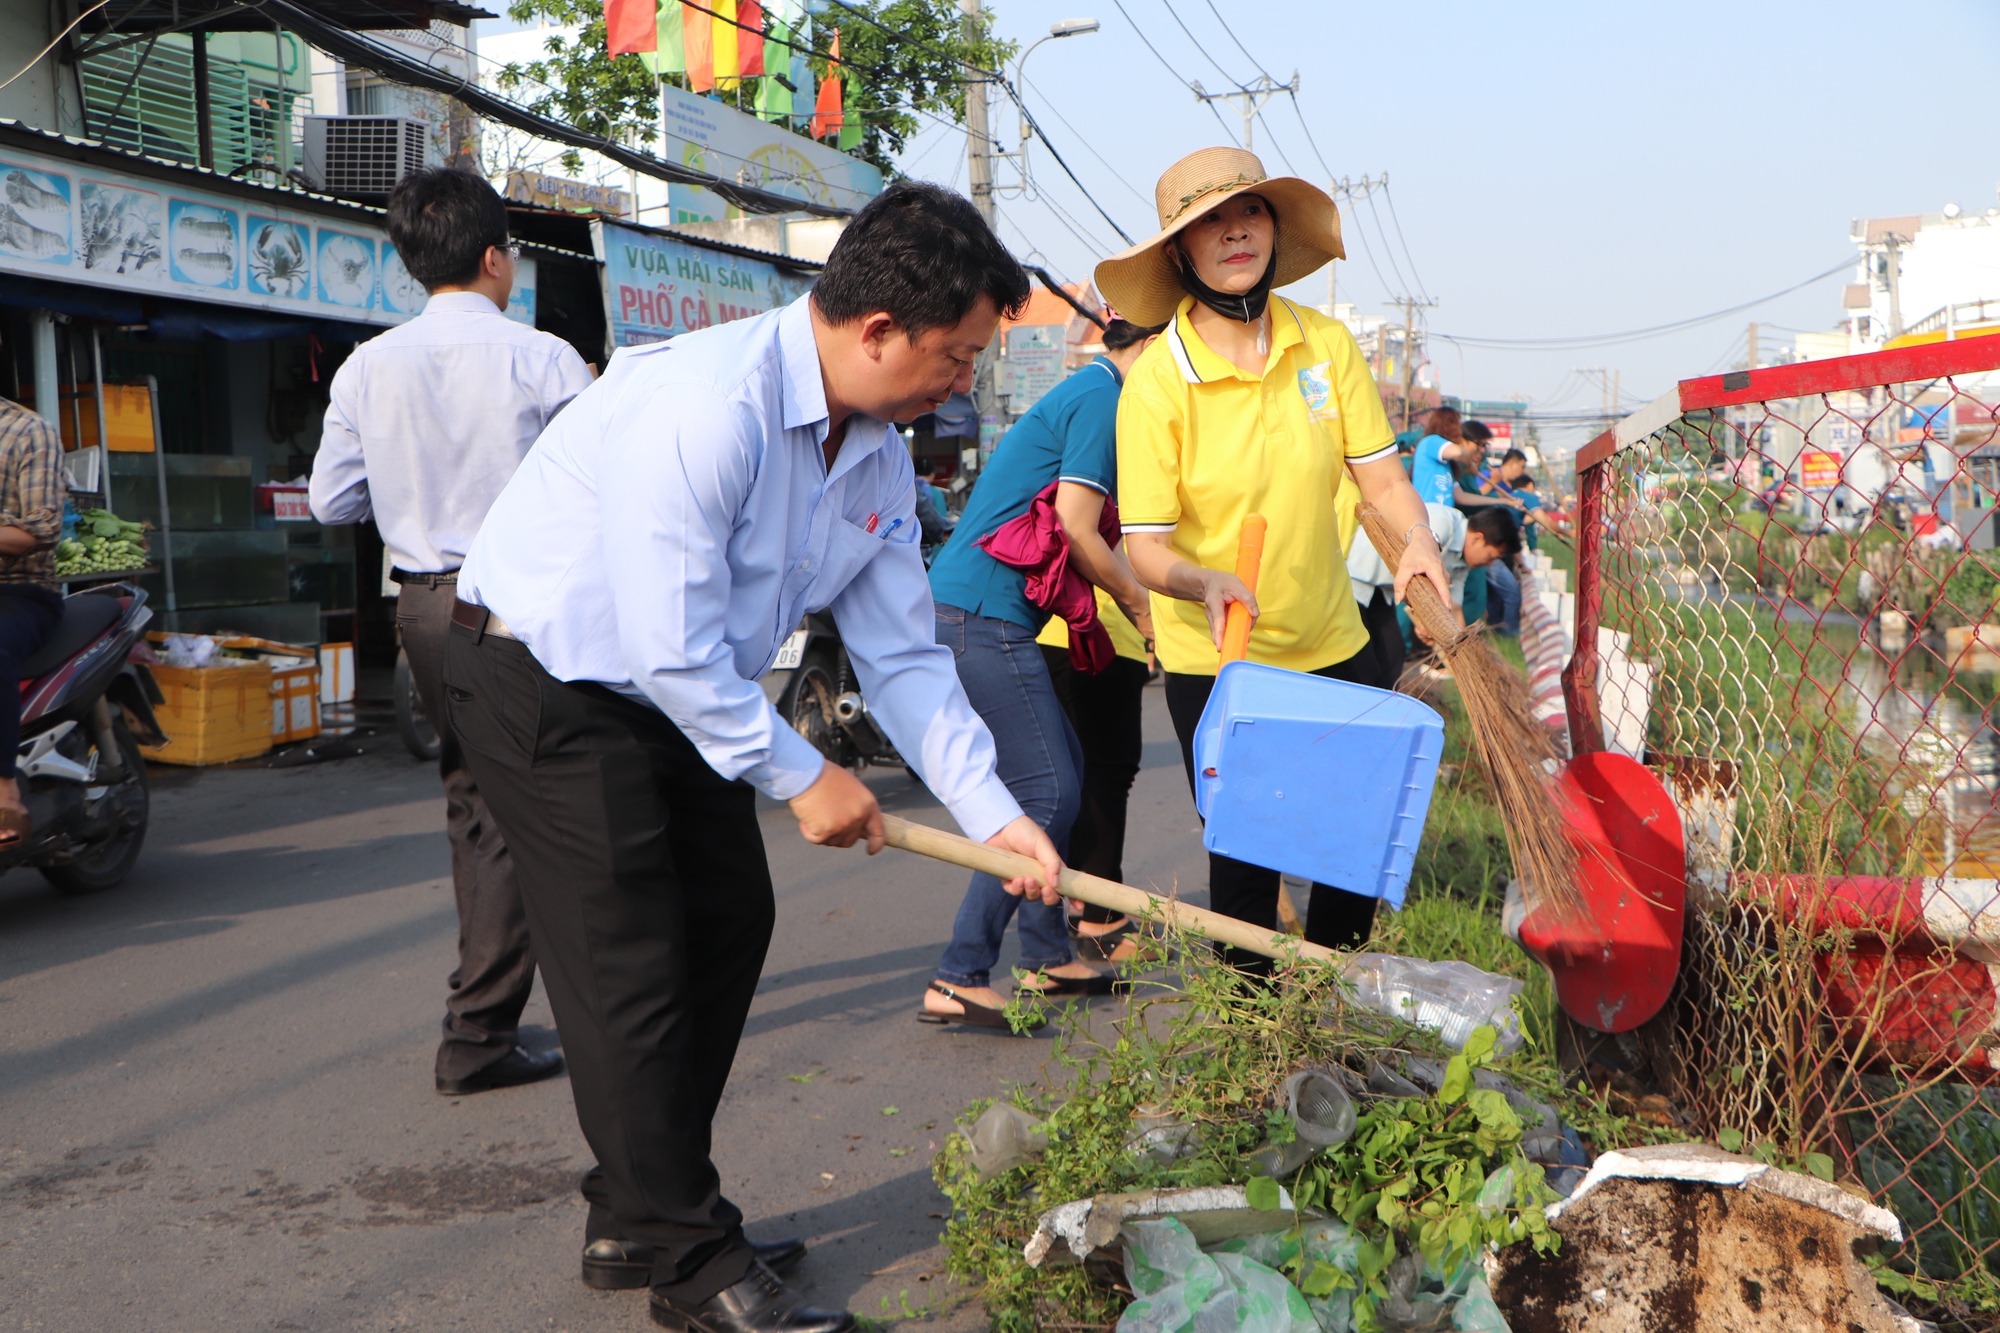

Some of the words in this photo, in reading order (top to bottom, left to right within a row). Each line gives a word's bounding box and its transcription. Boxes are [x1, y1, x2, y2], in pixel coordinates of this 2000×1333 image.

[624, 243, 670, 277] VỰA
[677, 251, 711, 284] HẢI
[717, 261, 754, 293] SẢN
[619, 282, 674, 329] PHỐ
[681, 290, 711, 331] CÀ
